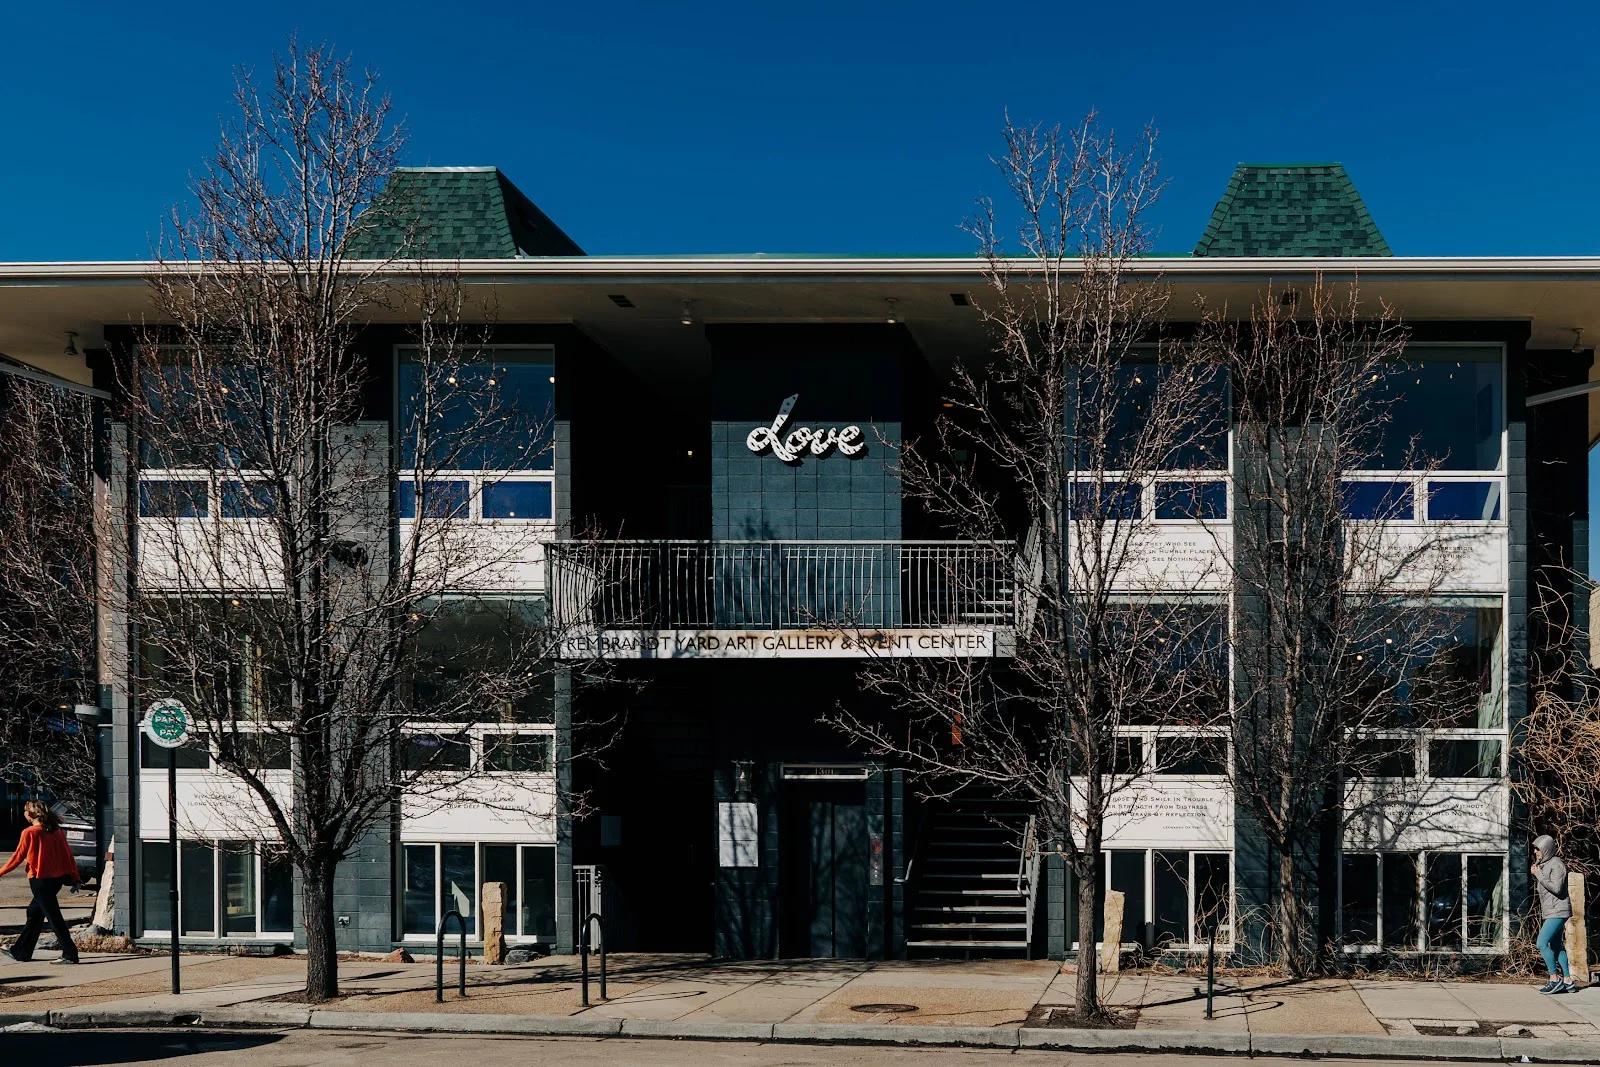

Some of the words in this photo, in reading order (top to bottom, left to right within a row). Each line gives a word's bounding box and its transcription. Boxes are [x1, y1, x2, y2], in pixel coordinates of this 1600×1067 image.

[567, 636, 672, 651] REMBRANDT
[676, 636, 720, 651] YARD
[725, 636, 759, 651] ART
[763, 635, 838, 650] GALLERY
[840, 635, 859, 651] &
[918, 634, 987, 650] CENTER
